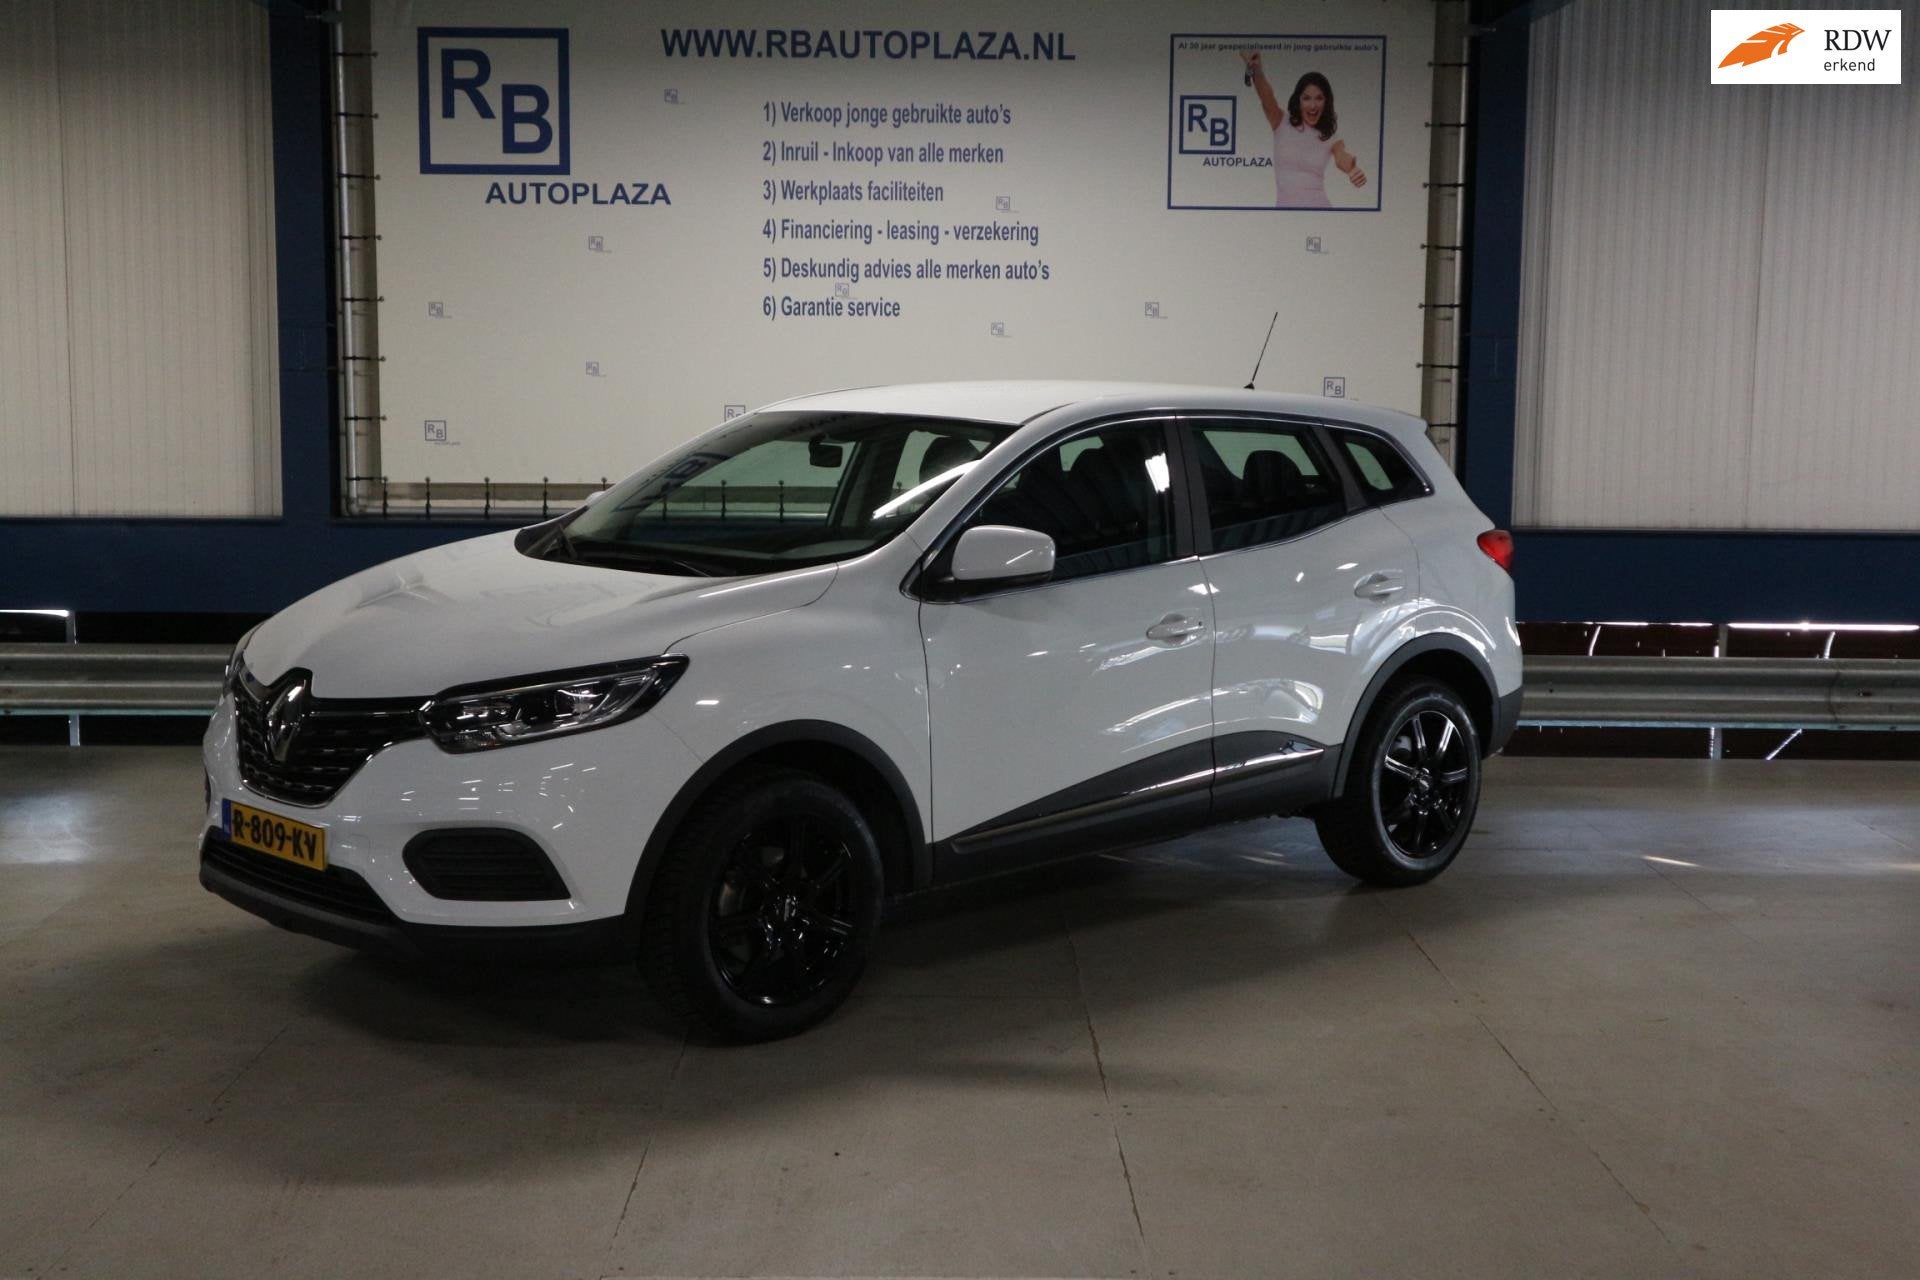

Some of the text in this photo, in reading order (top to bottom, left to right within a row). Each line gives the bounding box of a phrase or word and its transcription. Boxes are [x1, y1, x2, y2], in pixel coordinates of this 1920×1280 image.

[661, 29, 1076, 61] WWW.RBAUTOPLAZA.NL
[441, 48, 553, 154] RB
[763, 102, 1012, 129] 1) Verkoop jonge gebruikte auto's
[1188, 104, 1230, 146] RB
[763, 141, 777, 167] 2)
[782, 141, 818, 162] Inruil
[833, 142, 883, 167] Inkoop
[888, 147, 914, 163] van
[919, 142, 944, 163] alle
[949, 143, 1004, 163] merken
[1203, 157, 1273, 167] AUTOPLAZA
[485, 182, 671, 206] AUTOPLAZA
[763, 180, 944, 206] 3) Werkplaats faciliteiten
[763, 219, 777, 245] 4)
[782, 219, 872, 246] Financiering
[887, 220, 939, 246] leasing
[954, 221, 1039, 247] verzekering
[763, 258, 1050, 284] 5) Deskundig advies alle merken auto's
[763, 296, 900, 321] 6) Garantie service
[233, 809, 317, 861] R-809-KV
